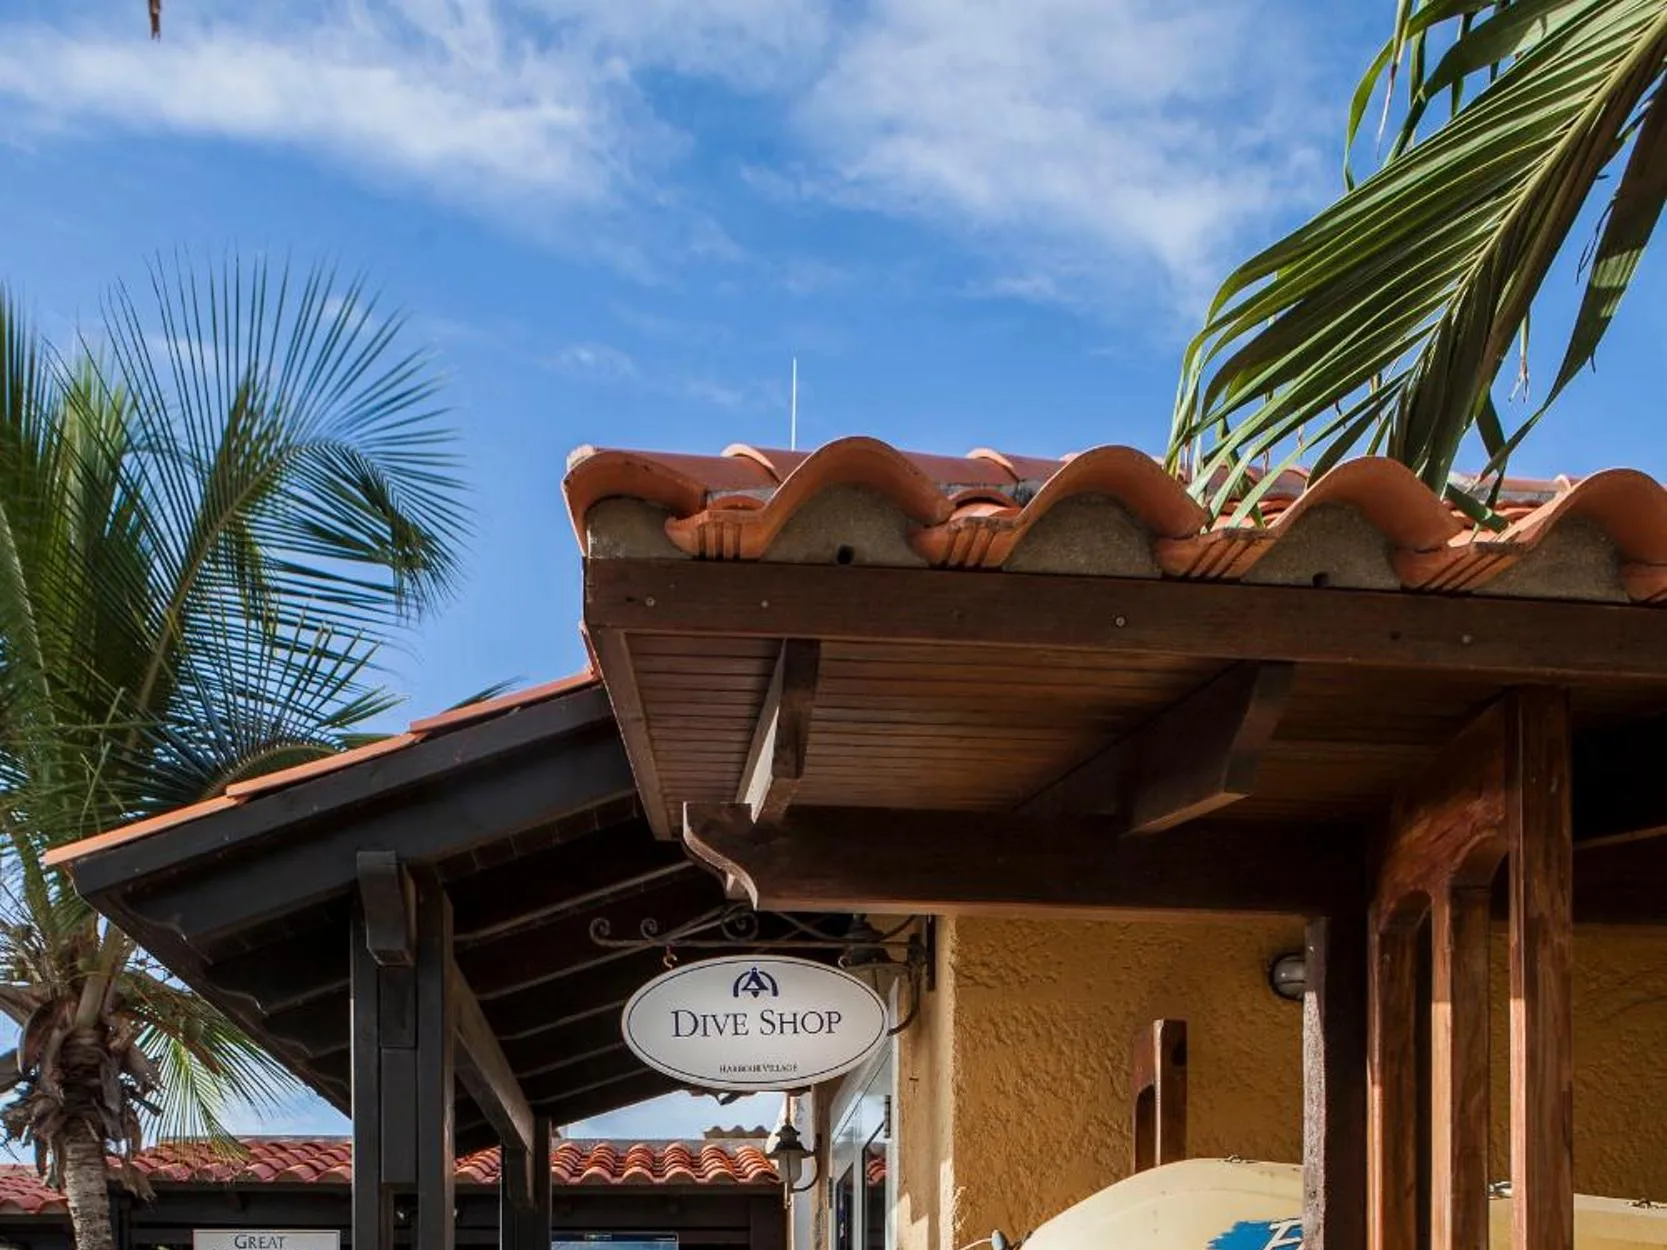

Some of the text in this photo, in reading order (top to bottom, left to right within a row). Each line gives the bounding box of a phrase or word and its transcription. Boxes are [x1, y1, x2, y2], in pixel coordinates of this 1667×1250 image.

[671, 1008, 842, 1038] DIVE SHOP
[234, 1234, 286, 1249] GREAT
